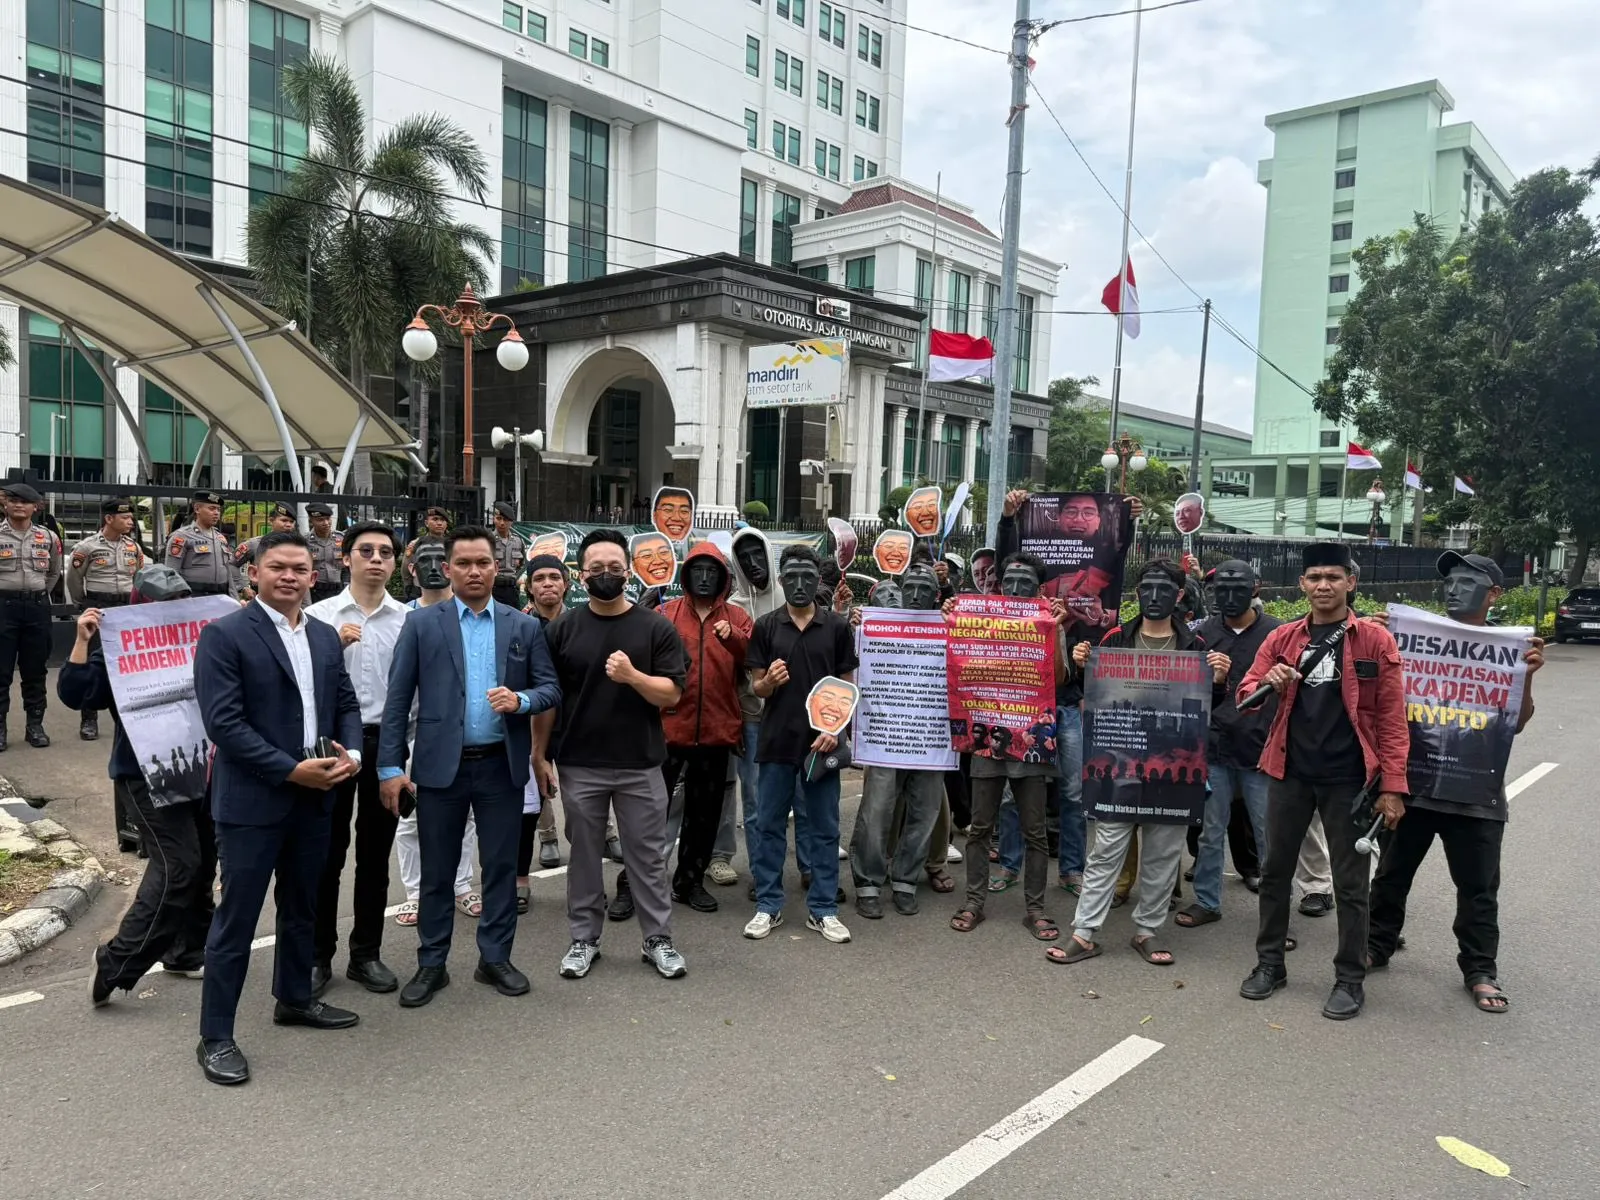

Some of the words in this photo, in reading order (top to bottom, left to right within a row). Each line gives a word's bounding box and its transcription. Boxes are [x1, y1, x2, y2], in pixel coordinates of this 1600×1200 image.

[764, 309, 812, 331] OTORITAS
[814, 321, 837, 337] JASA
[839, 327, 887, 349] KEUANGAN
[747, 365, 798, 383] mandiri
[748, 386, 764, 395] atm
[767, 383, 790, 394] setor
[792, 379, 813, 392] tarik
[959, 599, 986, 607] KEPADA
[987, 600, 1003, 608] PAK
[1004, 601, 1039, 610] PRESIDEN
[866, 624, 901, 633] MOHON
[955, 617, 1037, 632] INDONESIA
[120, 618, 217, 653] PENUNTA
[949, 628, 991, 638] NEGARA
[994, 631, 1046, 643] HUKUM!!
[1393, 632, 1519, 668] DESAKAN
[118, 648, 188, 676] AKADEMI
[1099, 652, 1134, 665] MOHON
[1137, 654, 1171, 667] ATENSI
[1174, 655, 1200, 669] ATAS
[1092, 666, 1136, 679] LAPORAN
[1401, 658, 1513, 687] ENUNTASAN
[1405, 675, 1509, 710] KADEMI
[960, 700, 998, 709] TOLONG
[1000, 703, 1039, 714] KAMI!!
[889, 712, 912, 720] CRYPTO
[968, 710, 1001, 718] TEGAKKAN
[1001, 713, 1032, 722] HUKUM
[1406, 702, 1488, 731] RYPTO
[864, 738, 887, 746] JANGAN
[884, 748, 927, 756] SELANJUTNYA
[1094, 802, 1114, 812] Jangan
[1114, 804, 1137, 814] biarkan
[1137, 806, 1154, 814] kasus
[1154, 806, 1162, 815] ini
